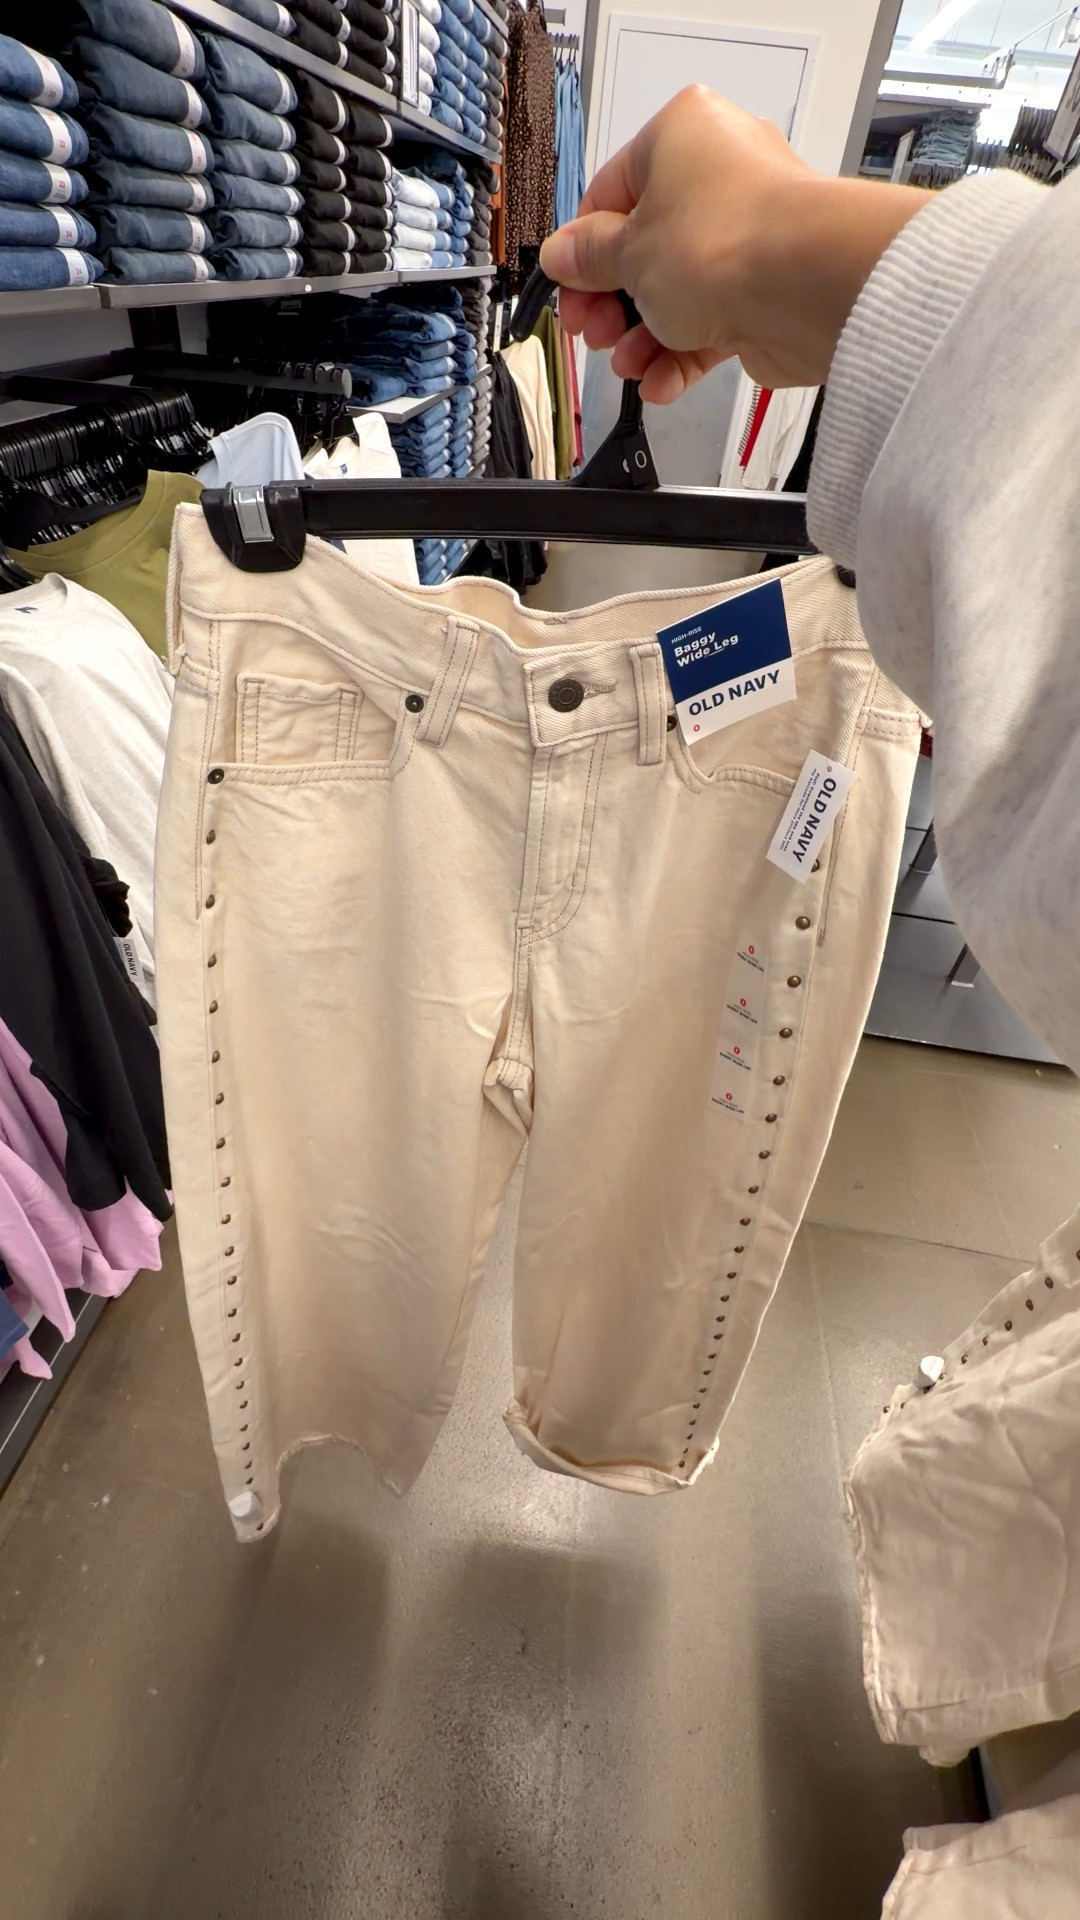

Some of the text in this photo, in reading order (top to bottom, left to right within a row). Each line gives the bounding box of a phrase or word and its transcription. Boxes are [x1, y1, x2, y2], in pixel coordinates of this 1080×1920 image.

[671, 626, 702, 644] HIGH-RISE
[674, 632, 716, 658] Baggy
[676, 634, 739, 668] Wide Leg
[688, 670, 780, 716] OLD NAVY
[801, 786, 814, 811] Download
[792, 778, 836, 863] OLD NAVY
[123, 943, 138, 976] OLD NAVY
